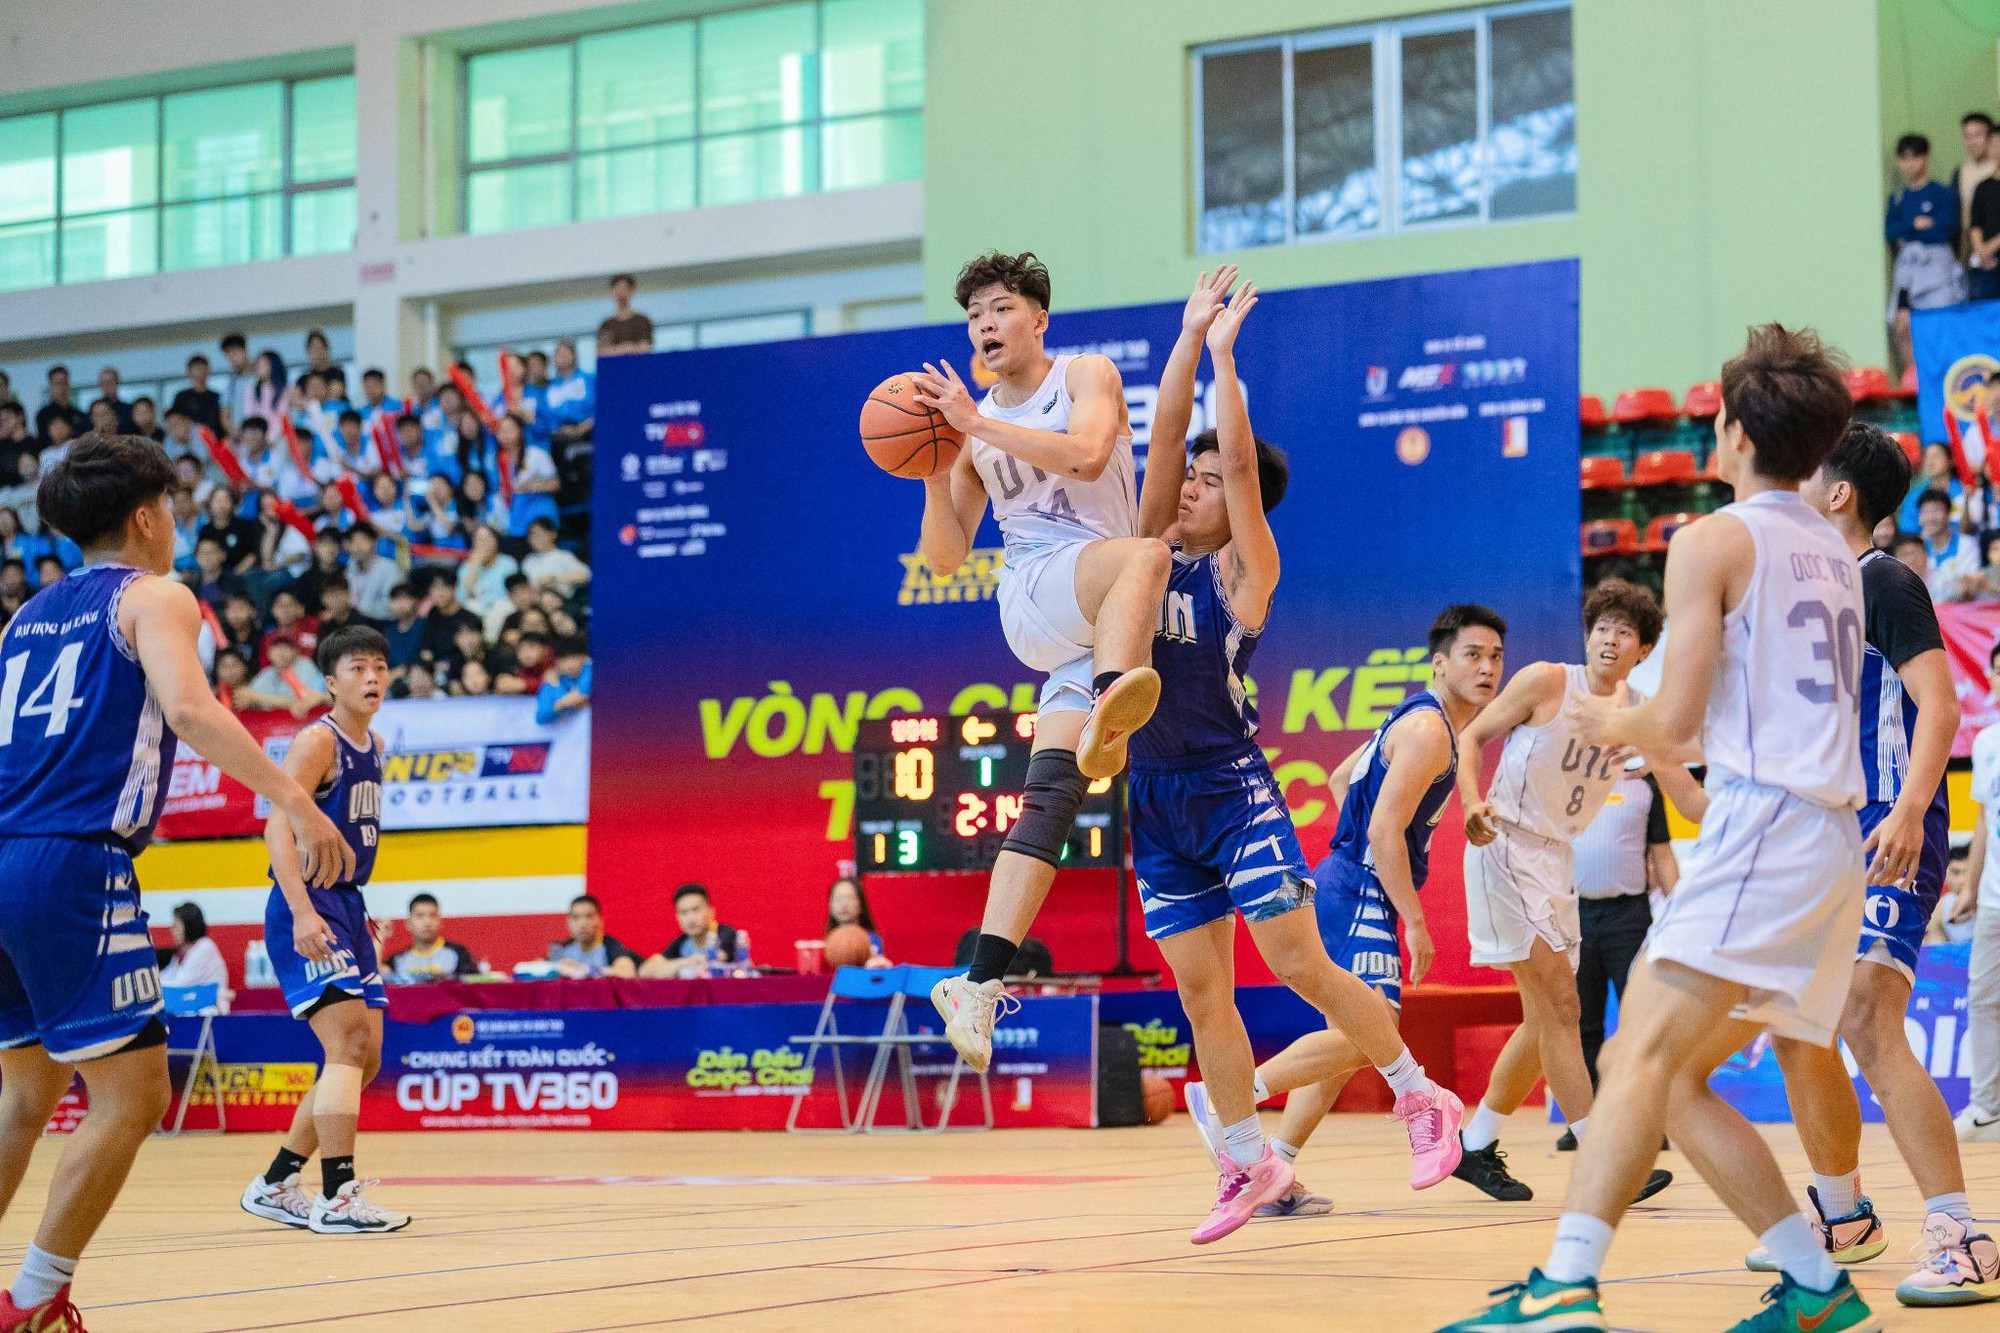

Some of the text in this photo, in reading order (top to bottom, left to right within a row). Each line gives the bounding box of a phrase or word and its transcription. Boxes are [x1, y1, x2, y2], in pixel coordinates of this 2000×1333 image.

[1787, 600, 1862, 714] 30
[0, 641, 84, 747] 14
[390, 782, 541, 806] OOTBALL
[895, 747, 992, 800] 10 1
[1566, 785, 1584, 816] 8
[874, 827, 1102, 865] 1 3 1
[397, 1068, 619, 1111] CÚP TV360
